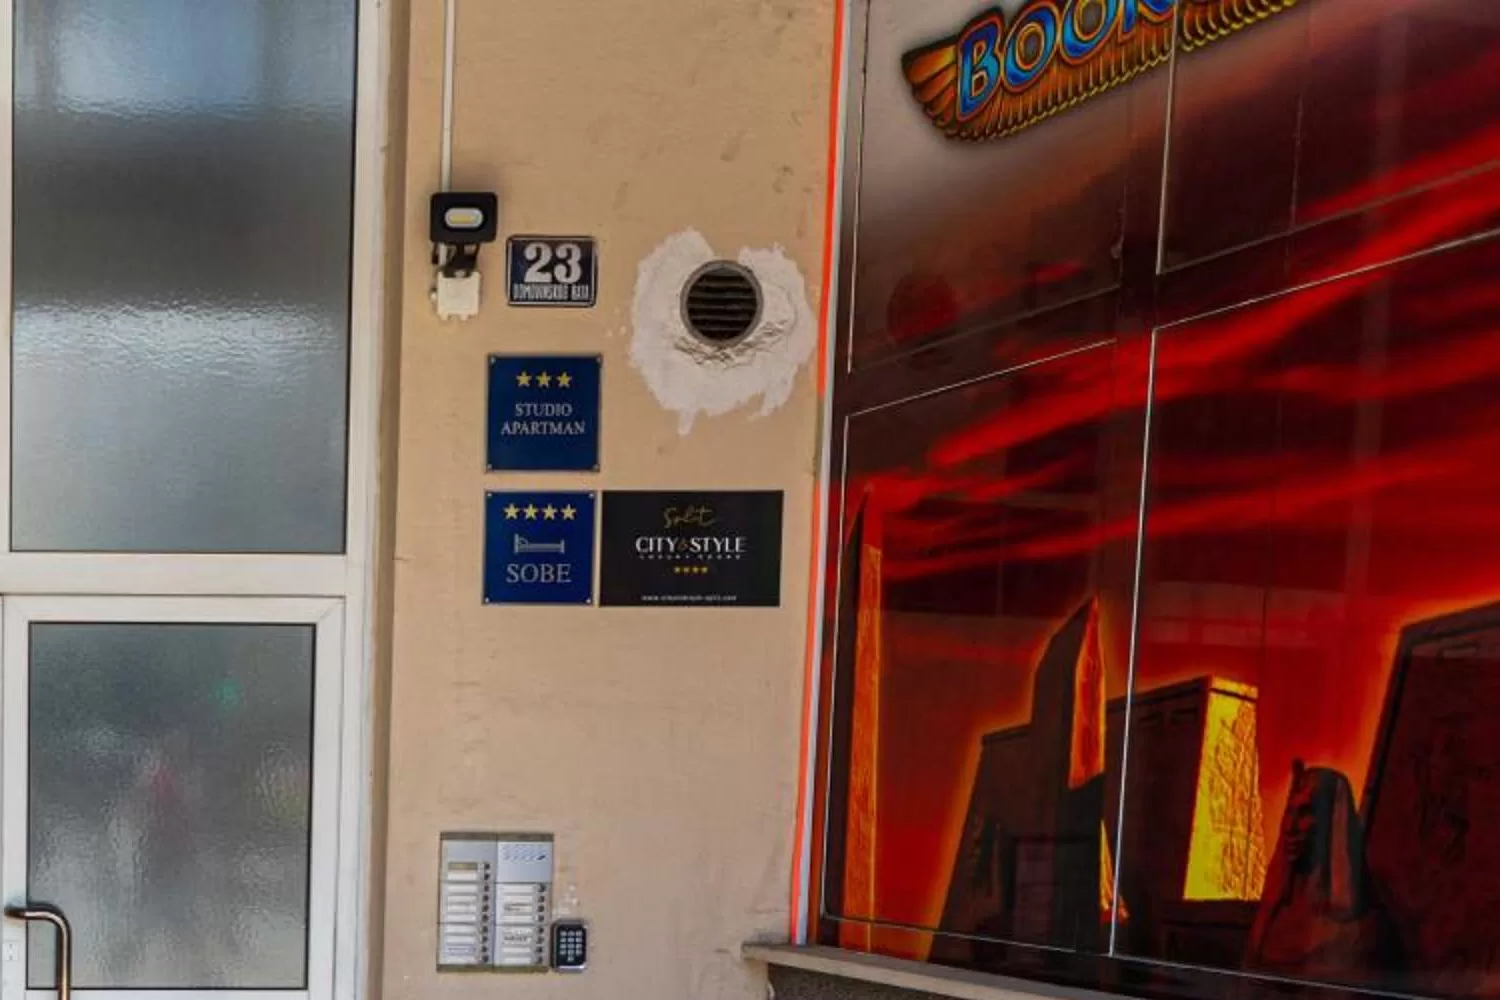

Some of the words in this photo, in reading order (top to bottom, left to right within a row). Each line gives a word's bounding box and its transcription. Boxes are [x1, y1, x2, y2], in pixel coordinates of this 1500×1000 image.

[524, 242, 582, 283] 23
[515, 403, 573, 417] STUDIO
[500, 420, 586, 435] APARTMAN
[505, 563, 573, 583] SOBE
